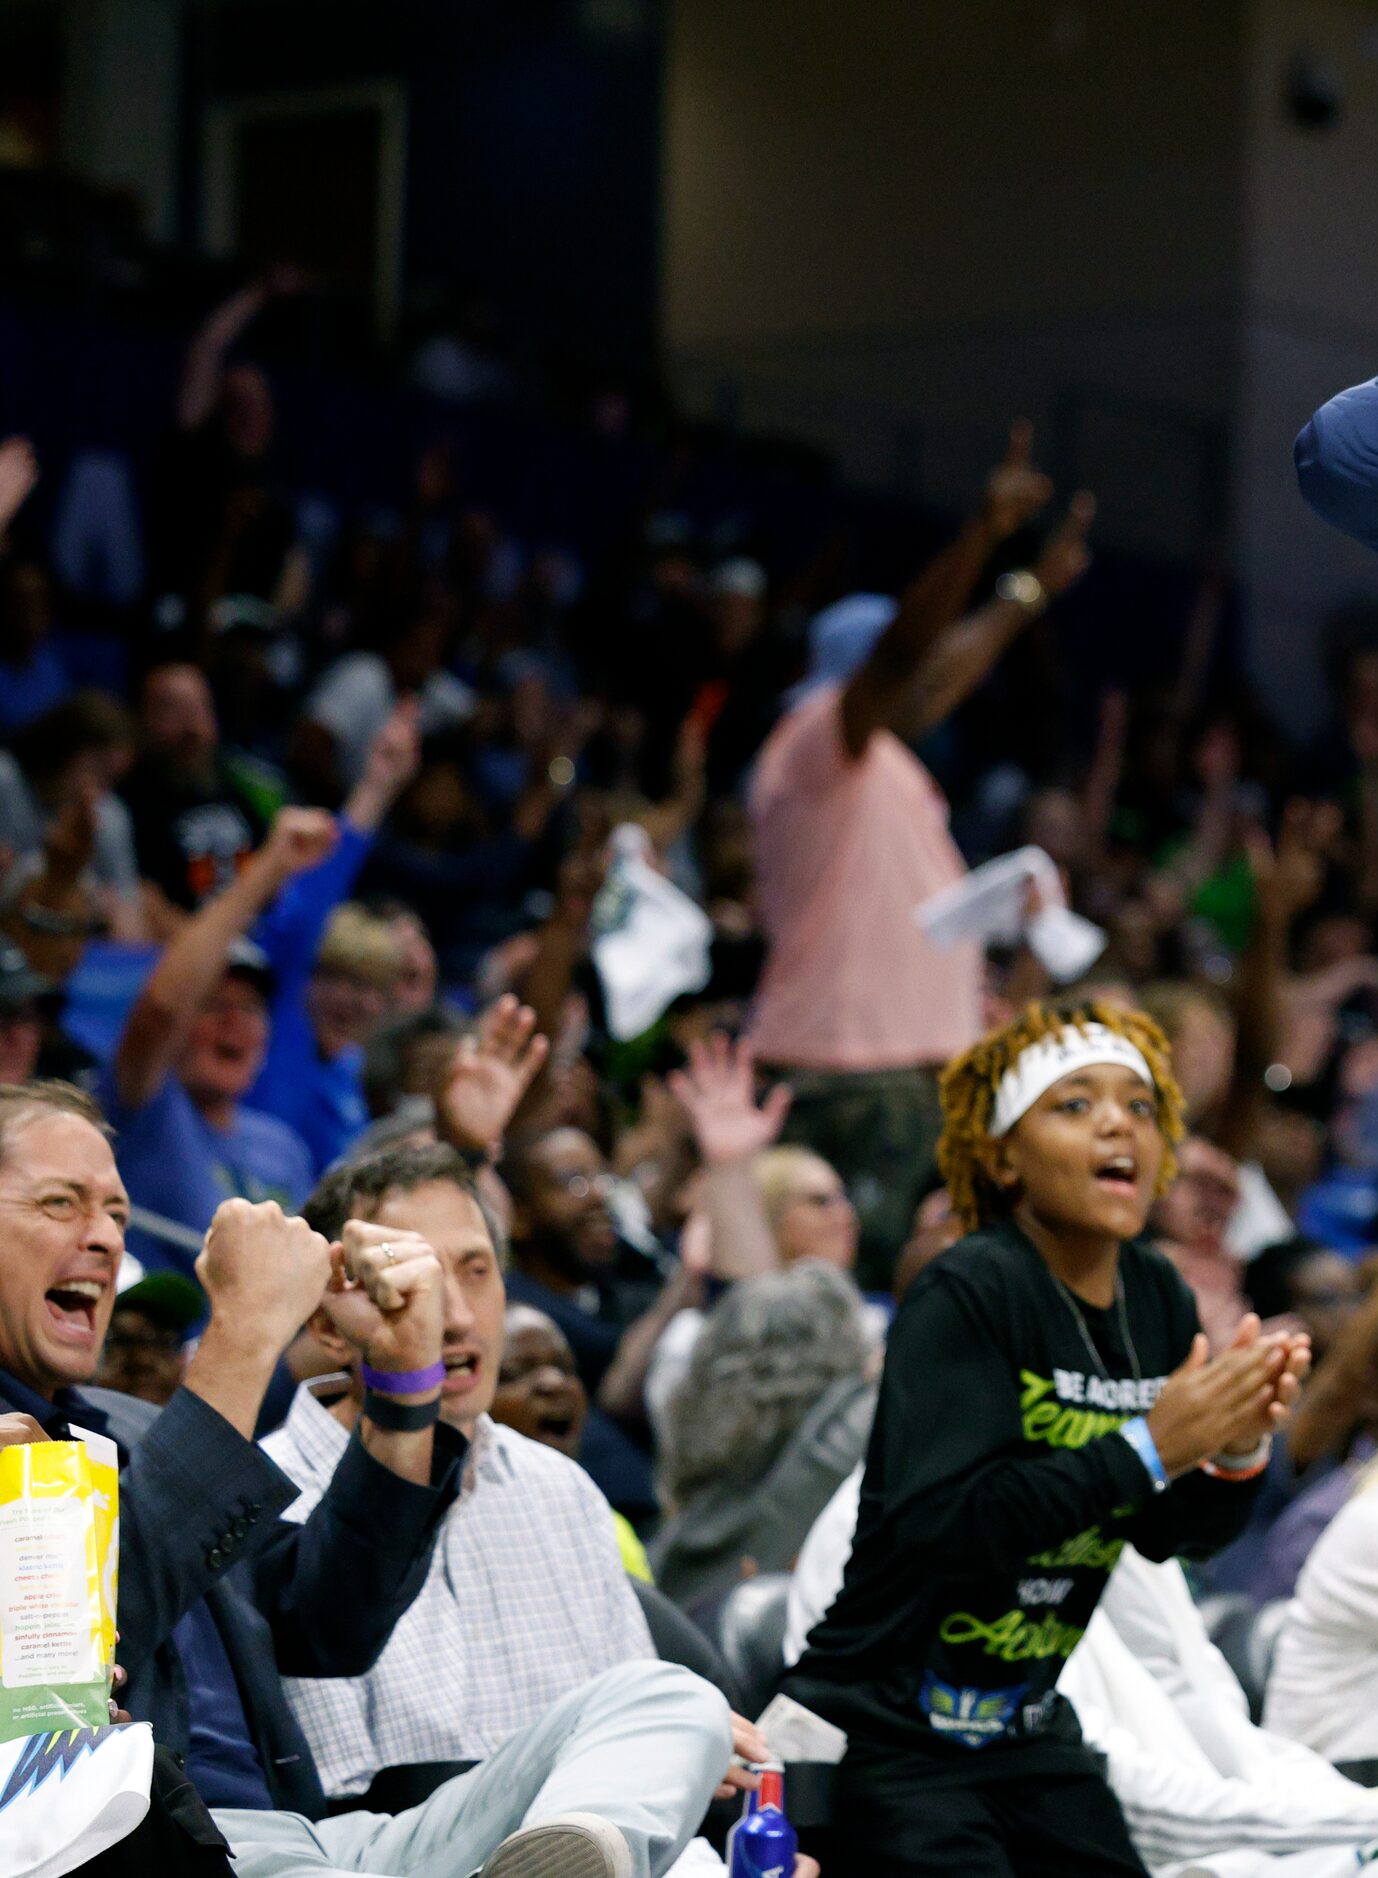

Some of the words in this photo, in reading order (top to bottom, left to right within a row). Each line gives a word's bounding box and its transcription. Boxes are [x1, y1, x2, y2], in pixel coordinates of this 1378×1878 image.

[1052, 1367, 1085, 1404] BE
[15, 1534, 43, 1543] caramel
[15, 1632, 40, 1641] sinfully
[21, 1641, 50, 1650] caramel
